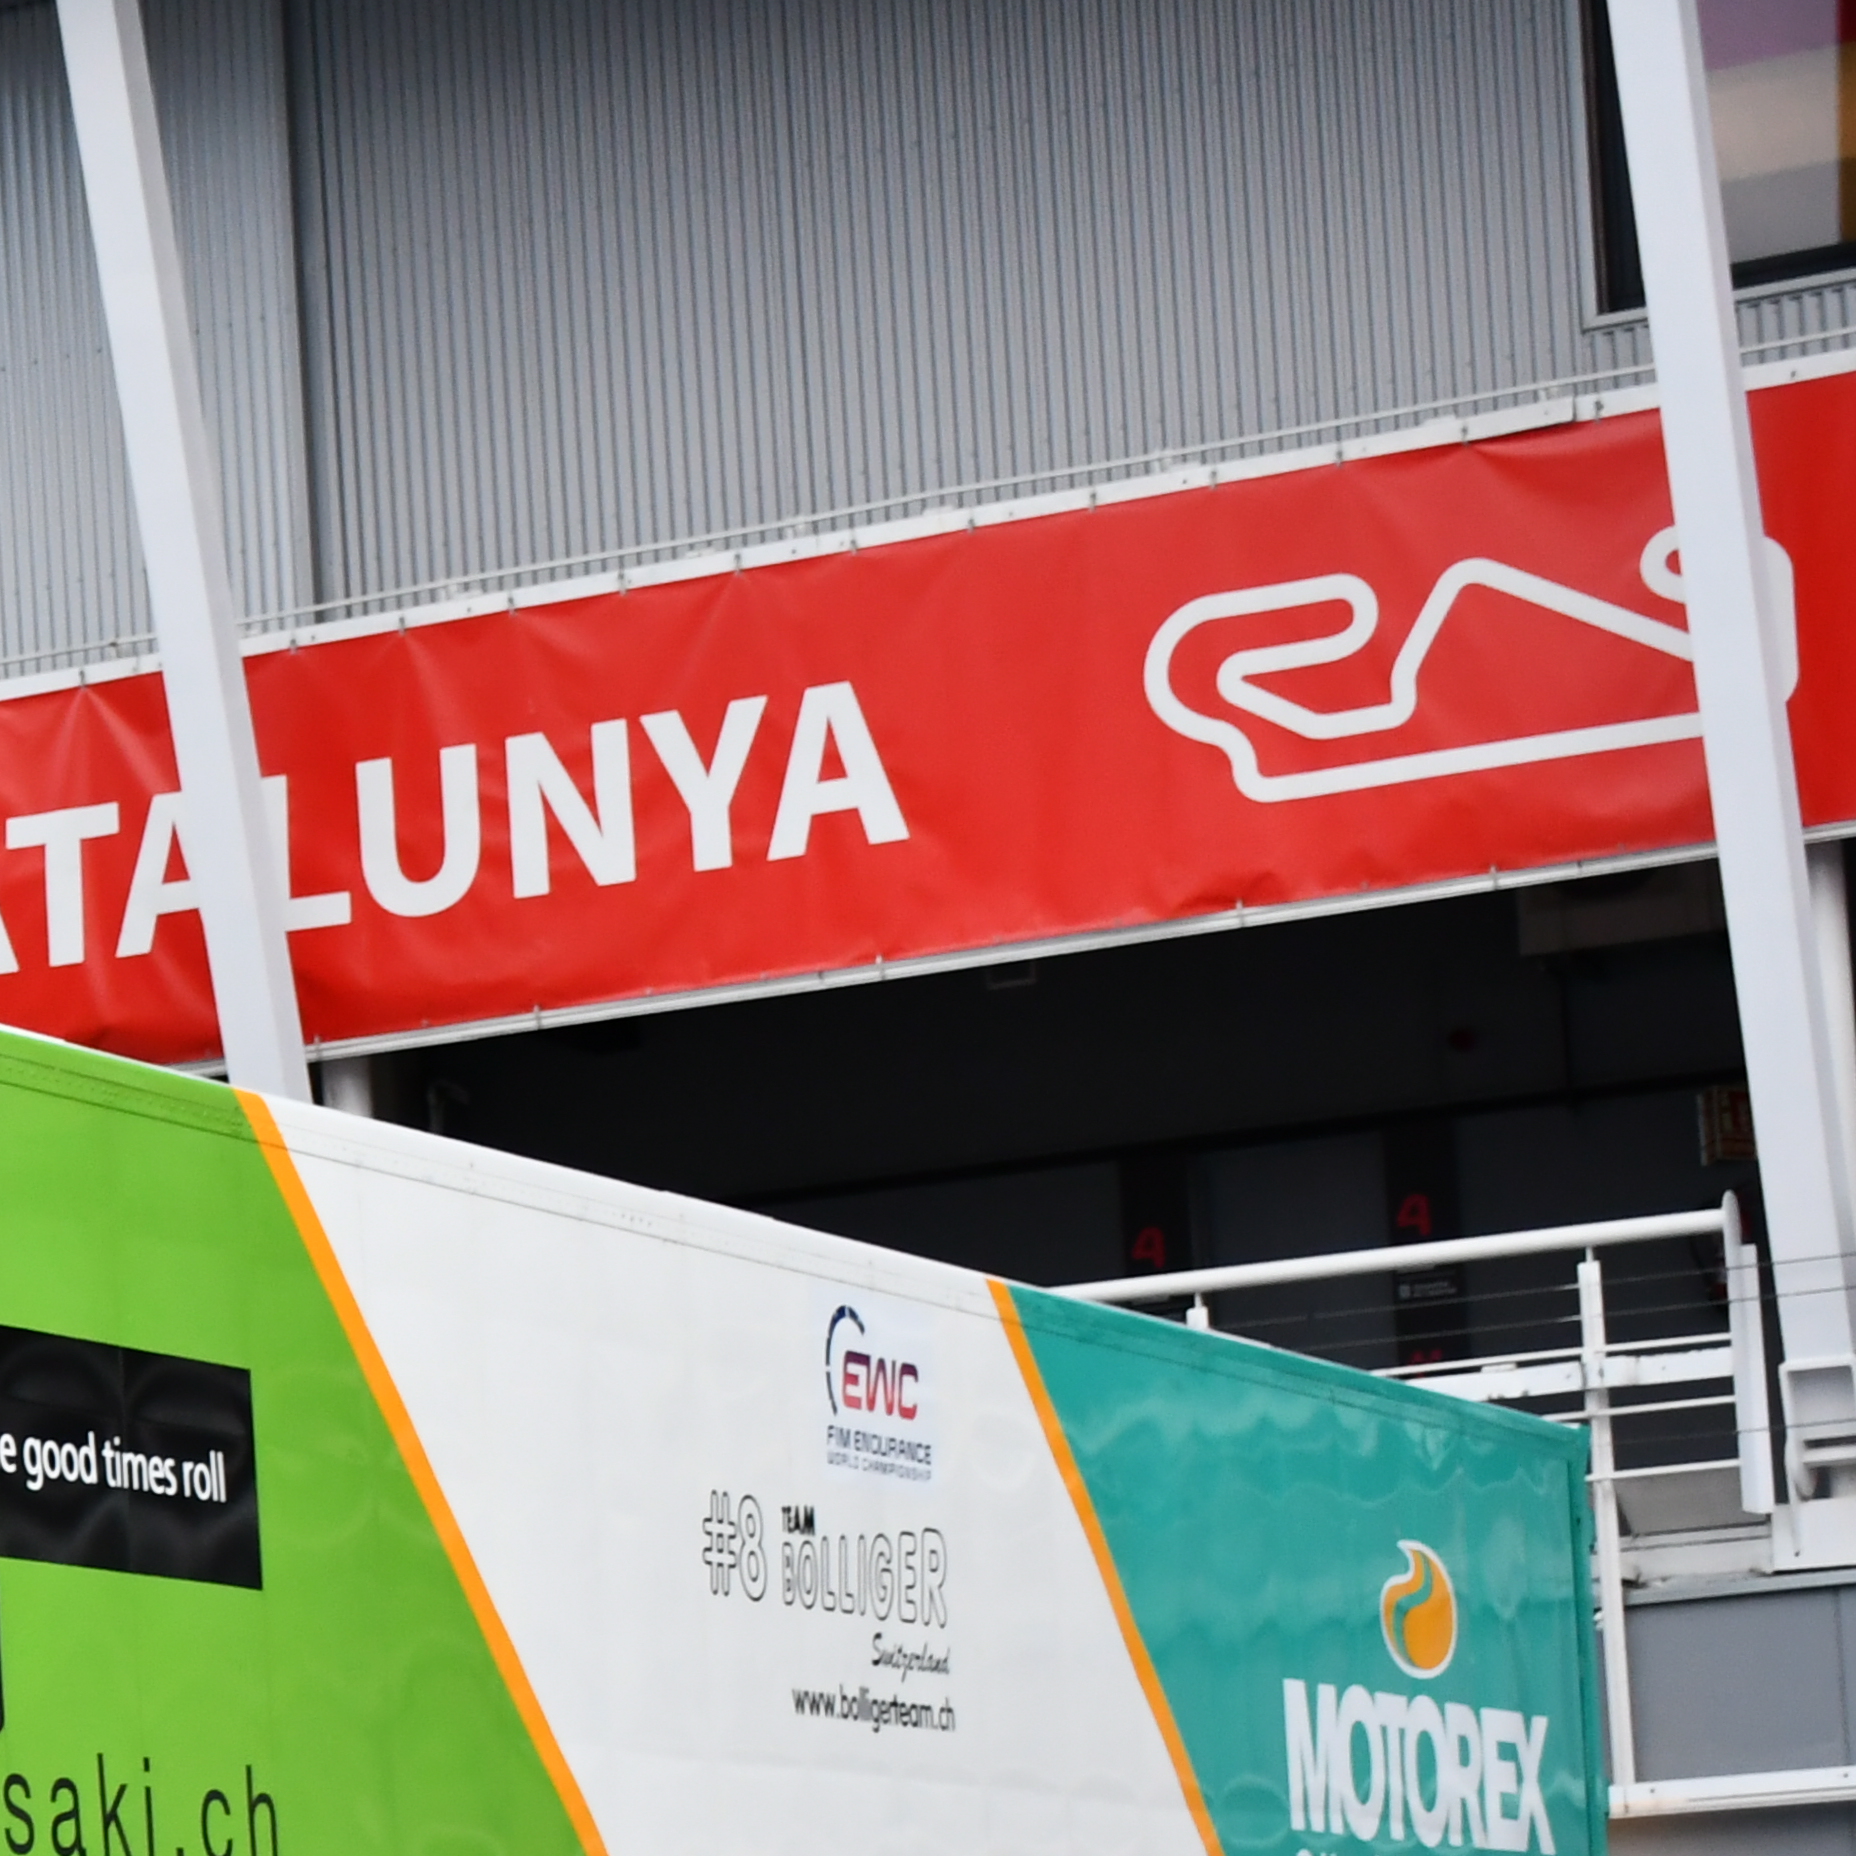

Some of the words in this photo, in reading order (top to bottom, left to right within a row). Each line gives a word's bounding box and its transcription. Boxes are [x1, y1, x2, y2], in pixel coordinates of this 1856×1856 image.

[842, 1351, 919, 1420] EWC
[22, 1432, 97, 1491] good
[102, 1437, 177, 1496] times
[182, 1450, 227, 1503] roll
[827, 1425, 851, 1449] FIM
[854, 1430, 931, 1466] ENDURANCE
[781, 1504, 816, 1536] TEAM
[702, 1489, 767, 1602] #8
[781, 1527, 949, 1629] BOLLIGER
[871, 1632, 951, 1682] Switzerland
[792, 1684, 955, 1733] www.bolligerteam.ch
[1283, 1678, 1556, 1856] MOTOREX
